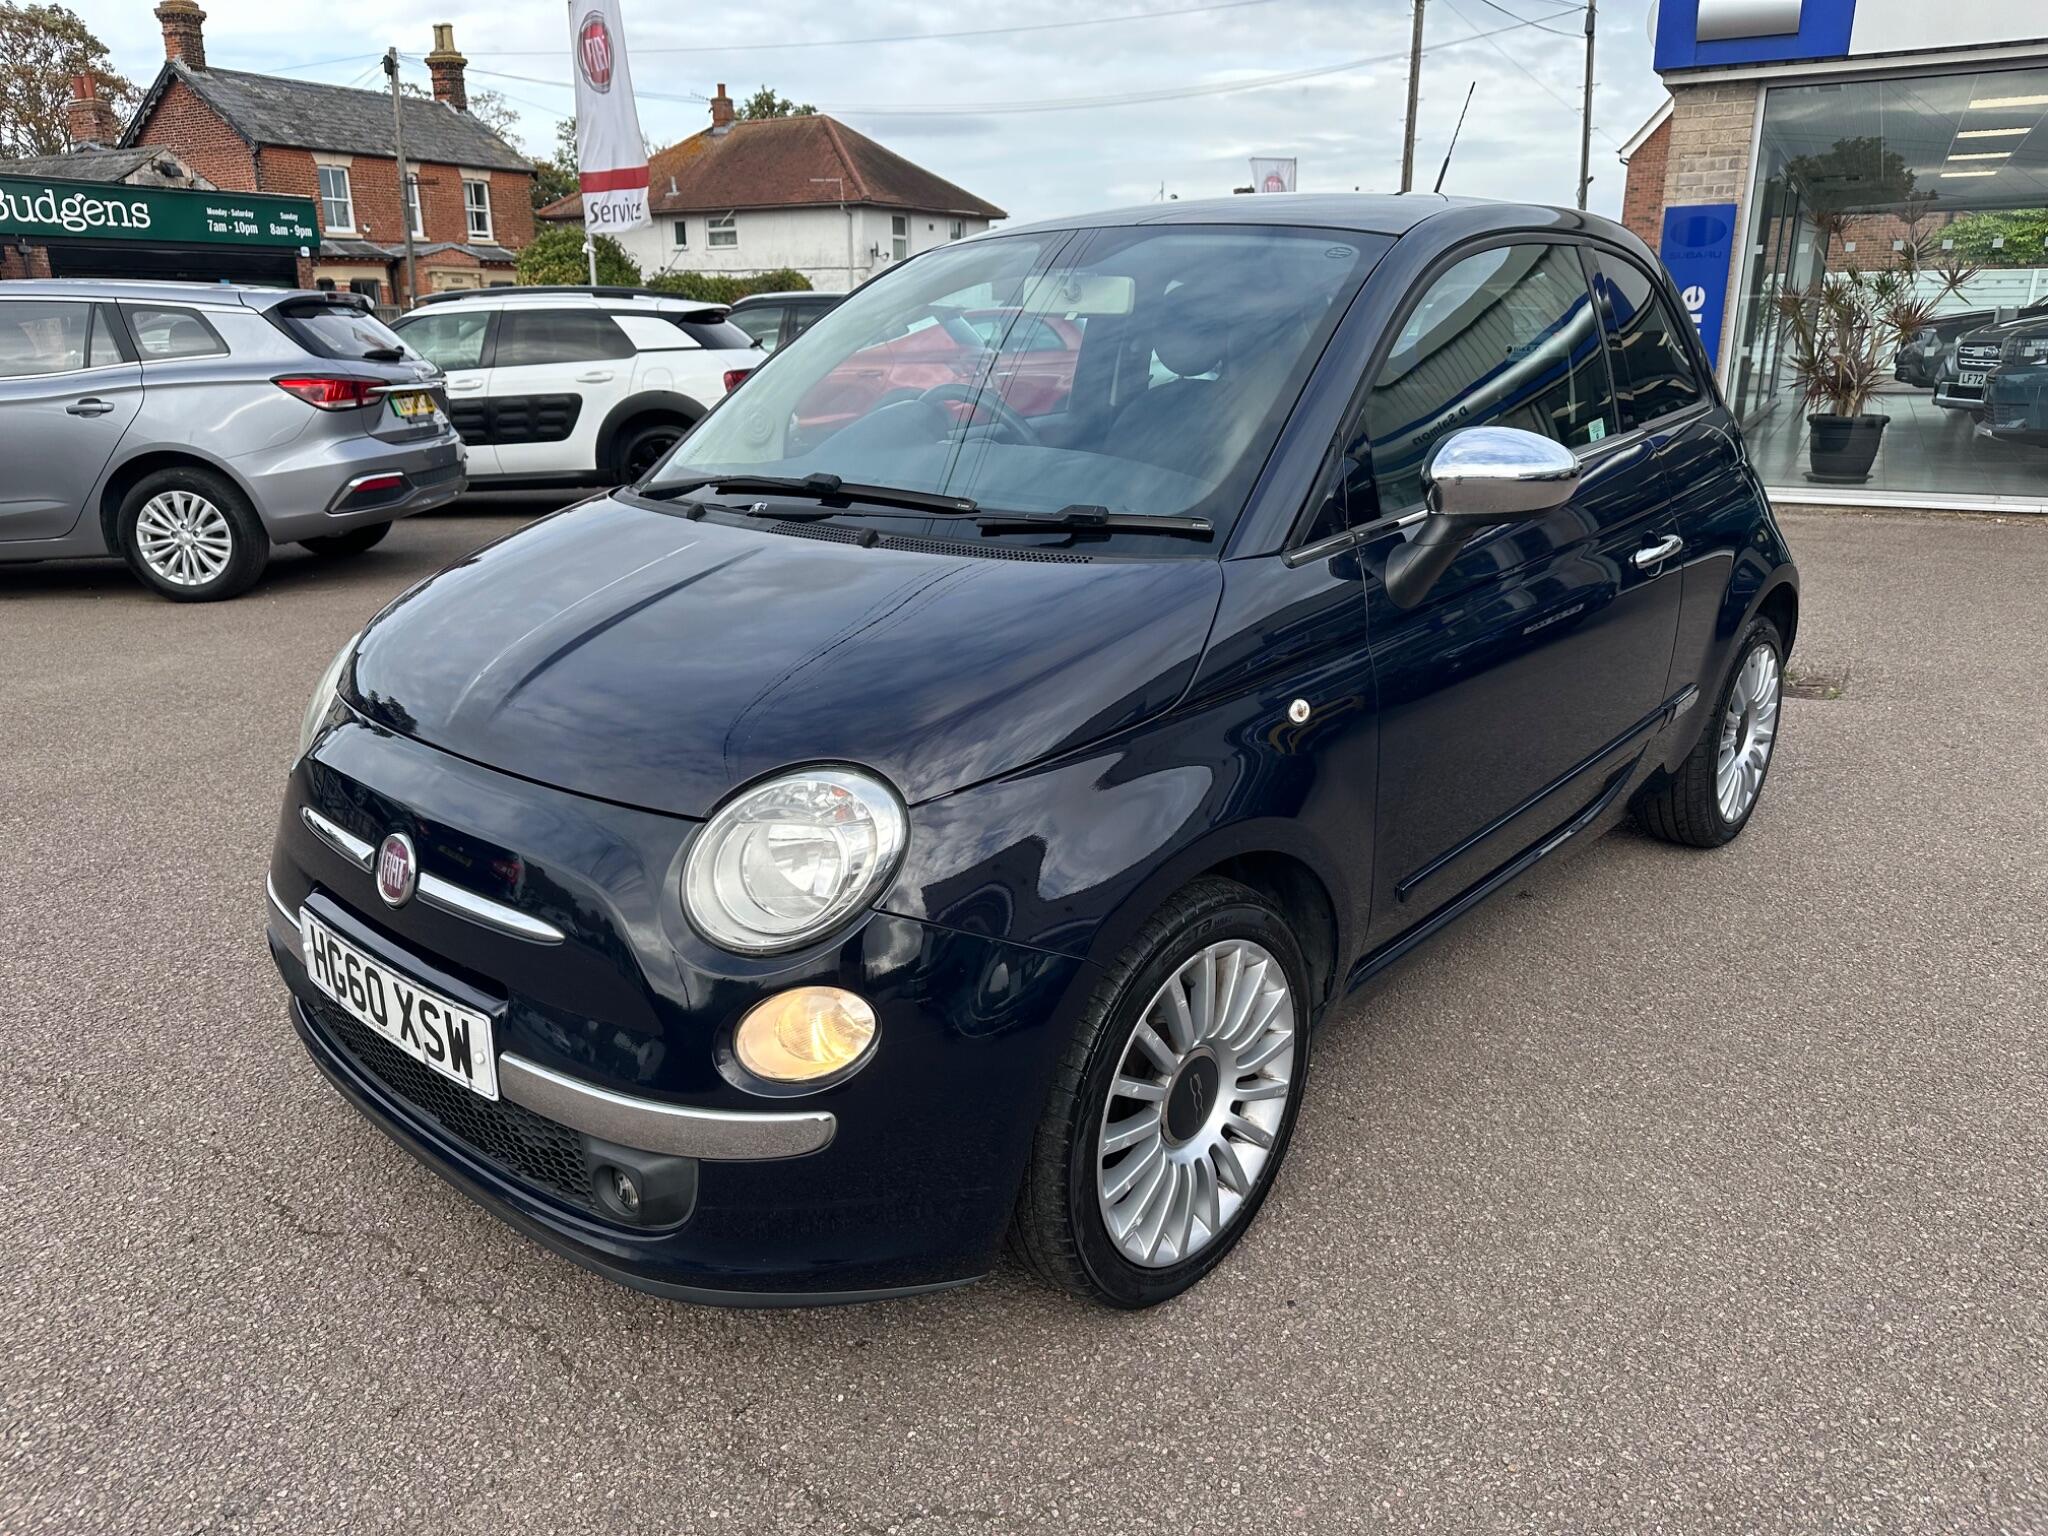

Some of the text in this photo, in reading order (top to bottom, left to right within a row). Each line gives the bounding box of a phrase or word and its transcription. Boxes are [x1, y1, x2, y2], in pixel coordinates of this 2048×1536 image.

[206, 207, 228, 218] Monday
[231, 209, 254, 219] Saturday
[280, 212, 298, 222] Sunday
[589, 197, 642, 224] Service
[207, 219, 228, 232] 7am
[234, 221, 258, 236] 10pm
[269, 223, 288, 235] 8am
[294, 224, 312, 239] 9pm
[1961, 373, 1984, 385] LF72
[383, 851, 407, 890] FIAT
[310, 924, 474, 1080] HG60 XSW
